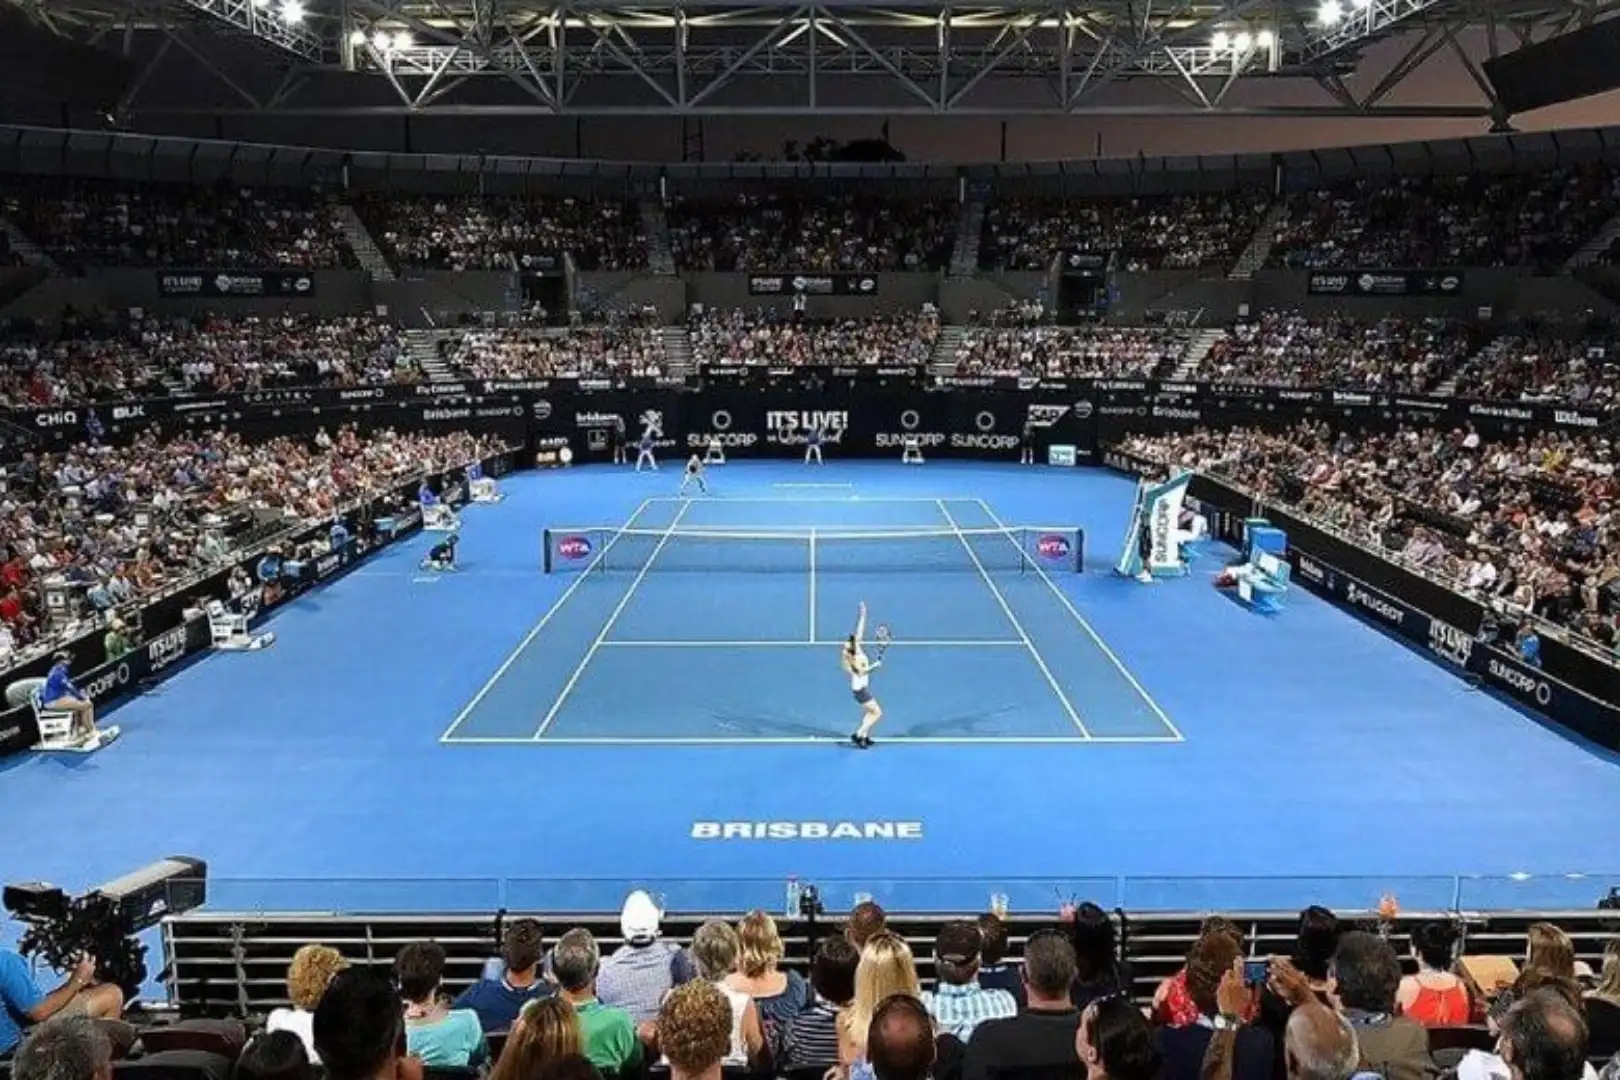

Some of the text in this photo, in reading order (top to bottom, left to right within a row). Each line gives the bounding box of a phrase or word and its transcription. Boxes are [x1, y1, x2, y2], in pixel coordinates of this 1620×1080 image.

[802, 410, 848, 430] LIVE!
[950, 433, 1021, 449] SUNCORP
[559, 542, 590, 553] WTA
[1038, 541, 1069, 553] WTA
[690, 820, 924, 839] BRISBANE
